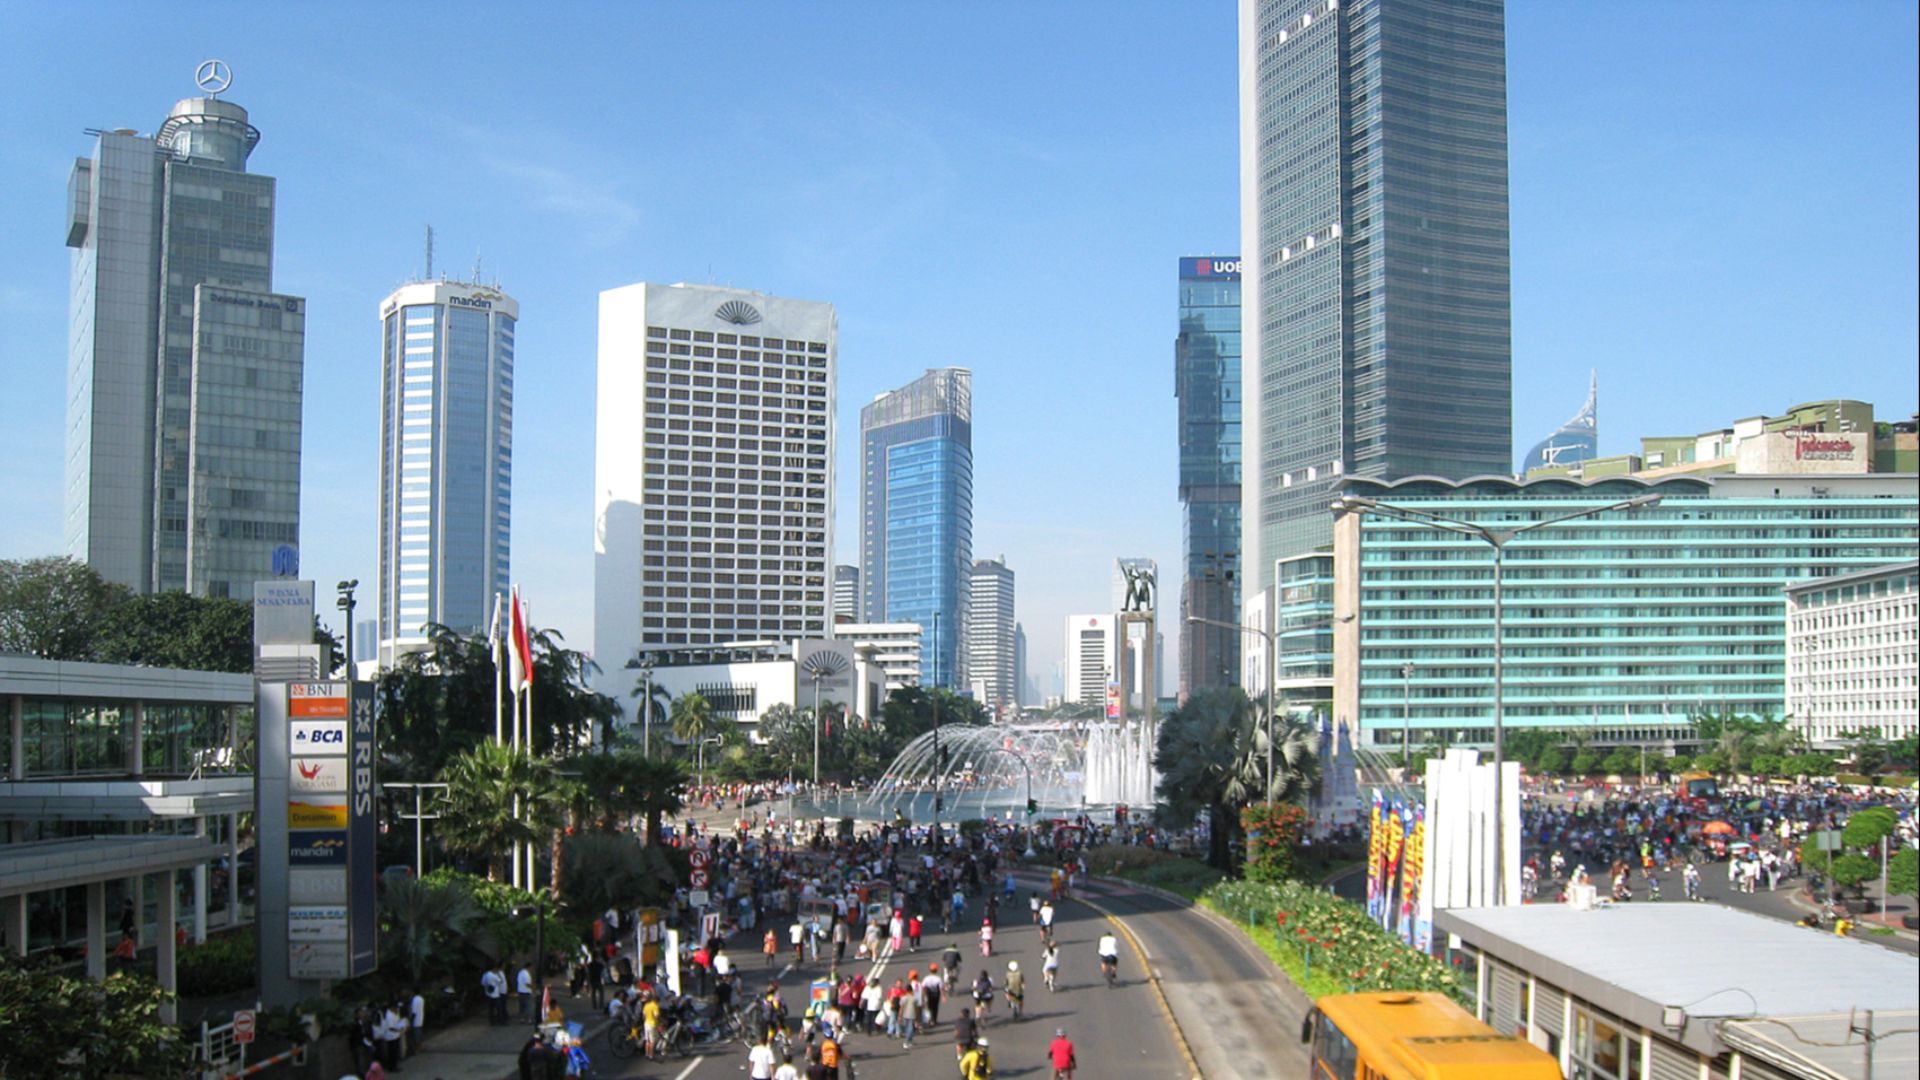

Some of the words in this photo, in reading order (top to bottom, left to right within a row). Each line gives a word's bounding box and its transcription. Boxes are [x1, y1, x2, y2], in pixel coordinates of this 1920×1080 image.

[307, 684, 332, 696] BNI
[311, 729, 343, 743] BCA
[355, 741, 371, 817] RBS
[290, 846, 334, 857] mandiri
